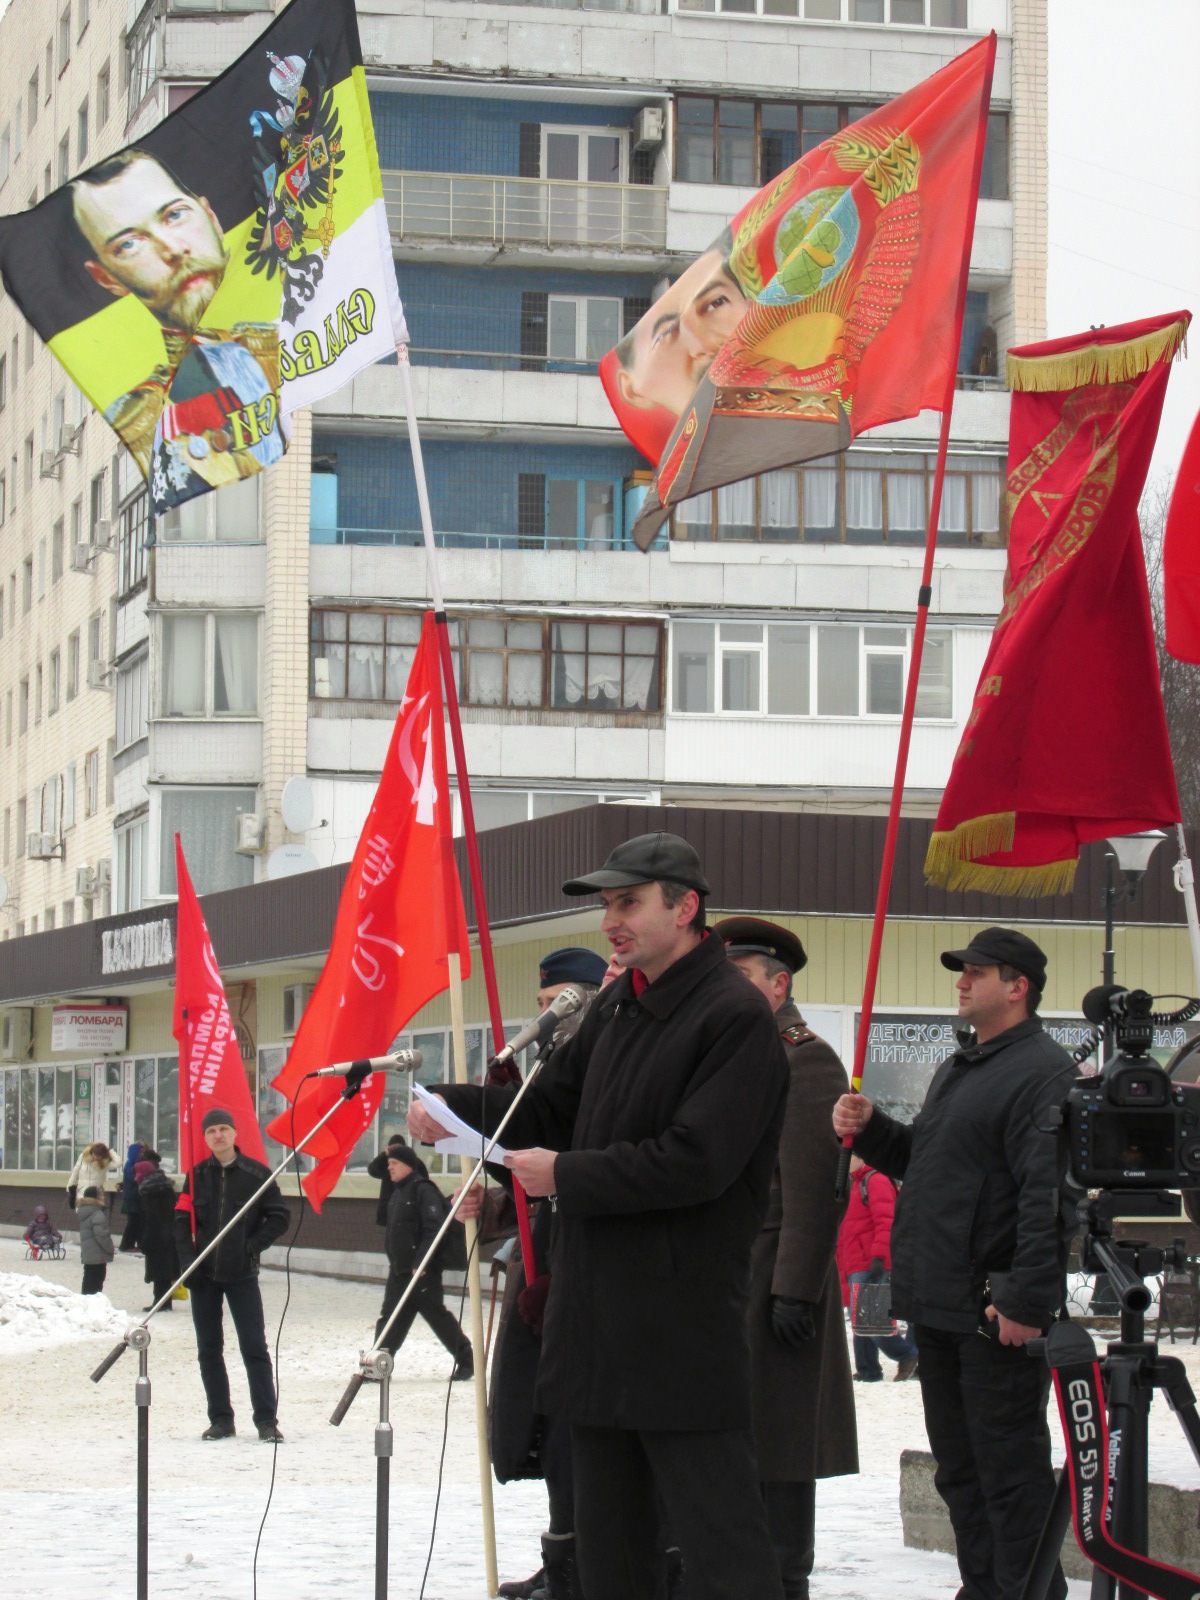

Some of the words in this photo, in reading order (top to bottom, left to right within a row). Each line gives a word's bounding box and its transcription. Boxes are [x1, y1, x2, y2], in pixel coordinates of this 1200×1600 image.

[69, 1015, 124, 1028] ЛОМБАРД
[868, 1023, 953, 1044] ДЕТСКОЕ
[871, 1045, 956, 1063] ПИТАНИЕ
[1068, 1379, 1096, 1443] EOS
[1080, 1449, 1098, 1480] 5D
[1108, 1429, 1122, 1479] Velbon
[1082, 1486, 1095, 1525] Mark
[1084, 1525, 1094, 1542] III
